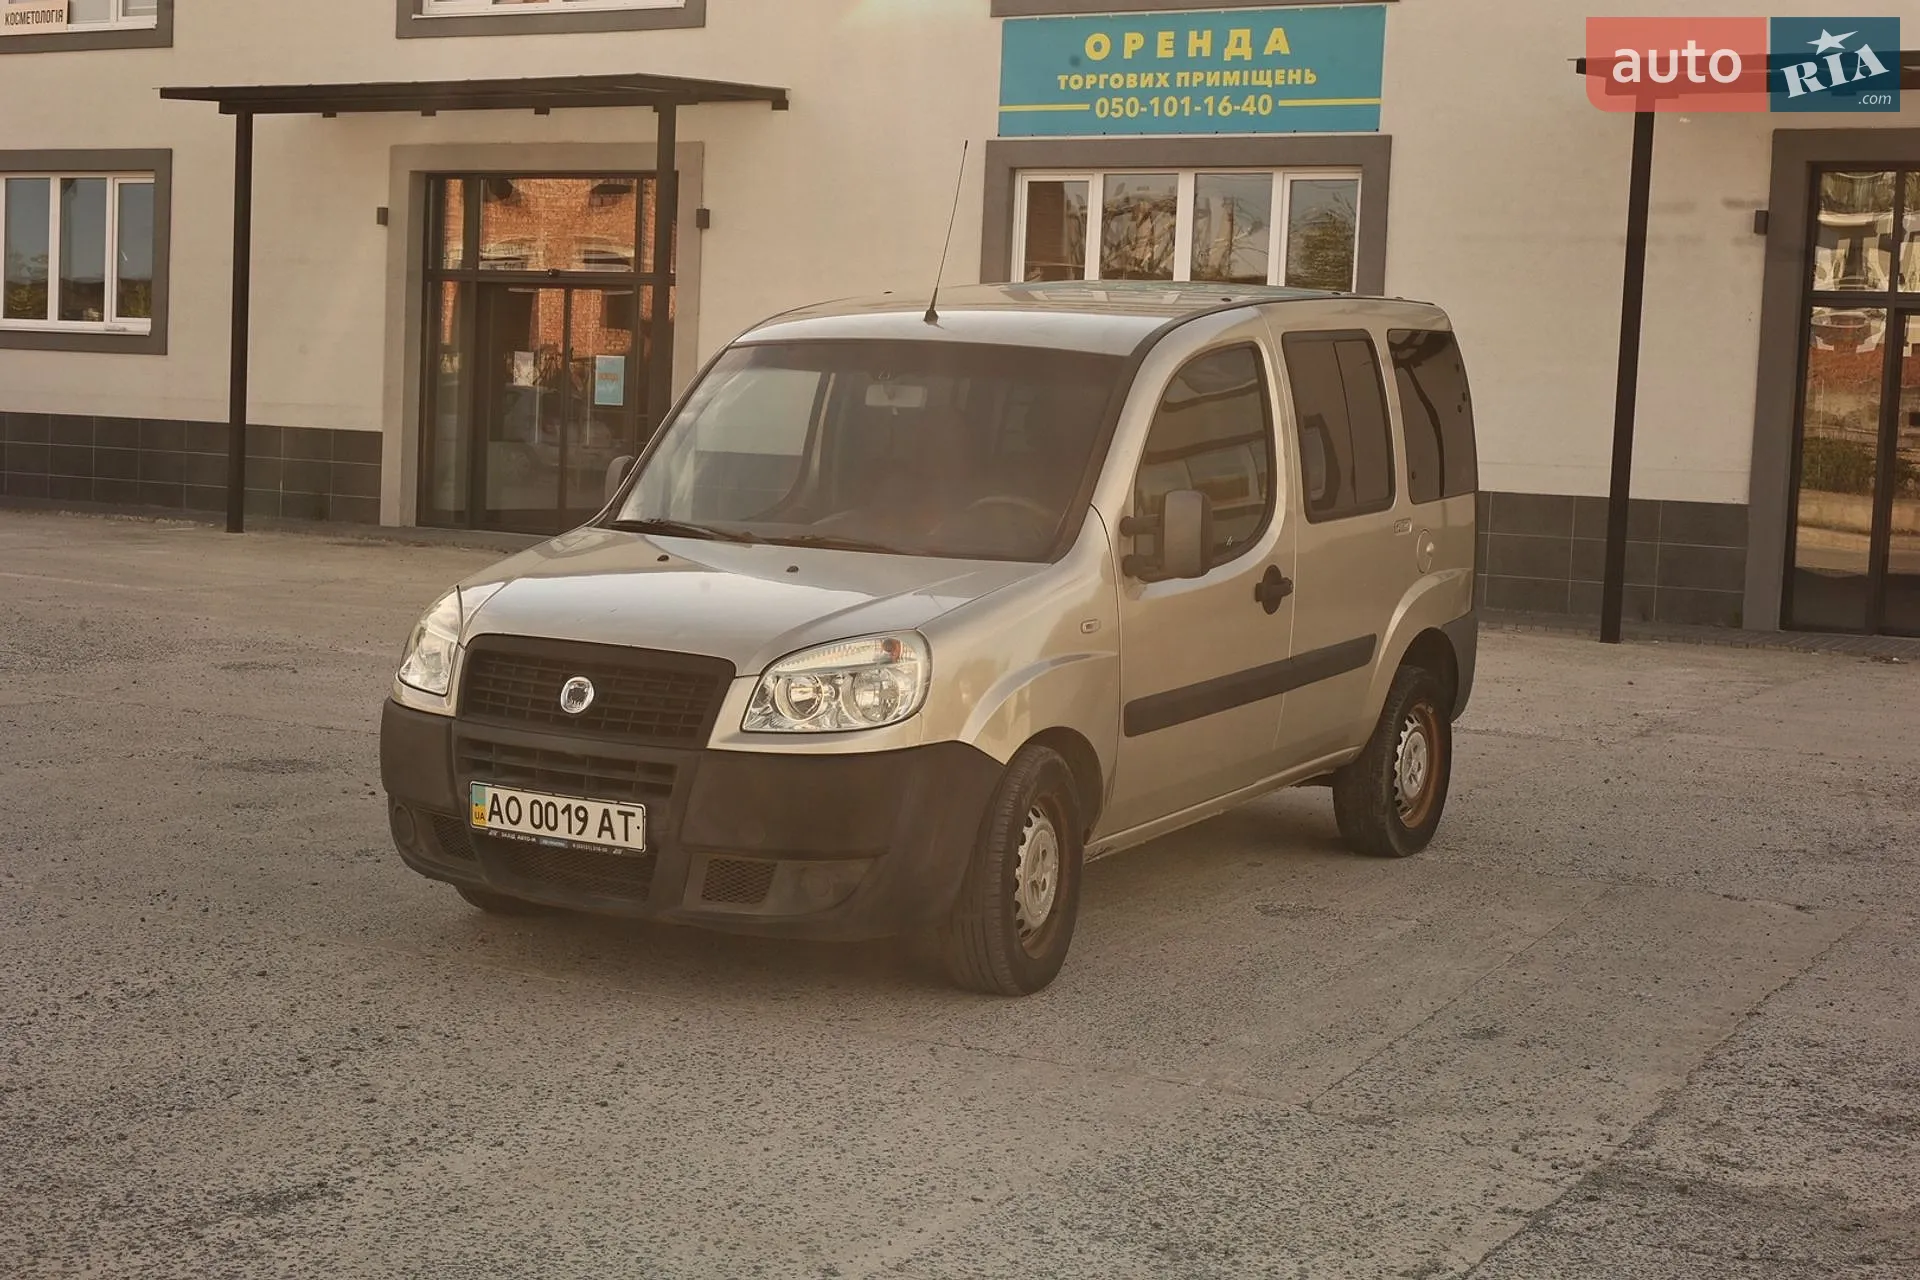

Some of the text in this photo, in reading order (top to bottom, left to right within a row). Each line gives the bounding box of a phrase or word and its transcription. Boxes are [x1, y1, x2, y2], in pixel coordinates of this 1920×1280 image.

[4, 9, 63, 26] КОСМЕТОЛОГІЯ
[1084, 27, 1290, 61] ОРЕНДА
[1057, 68, 1317, 90] ТОРГОВИХ ПРИМІЩЕНЬ
[1095, 94, 1273, 118] 050-101-16-40
[474, 811, 486, 821] UA
[488, 793, 636, 842] AO 0019 AT
